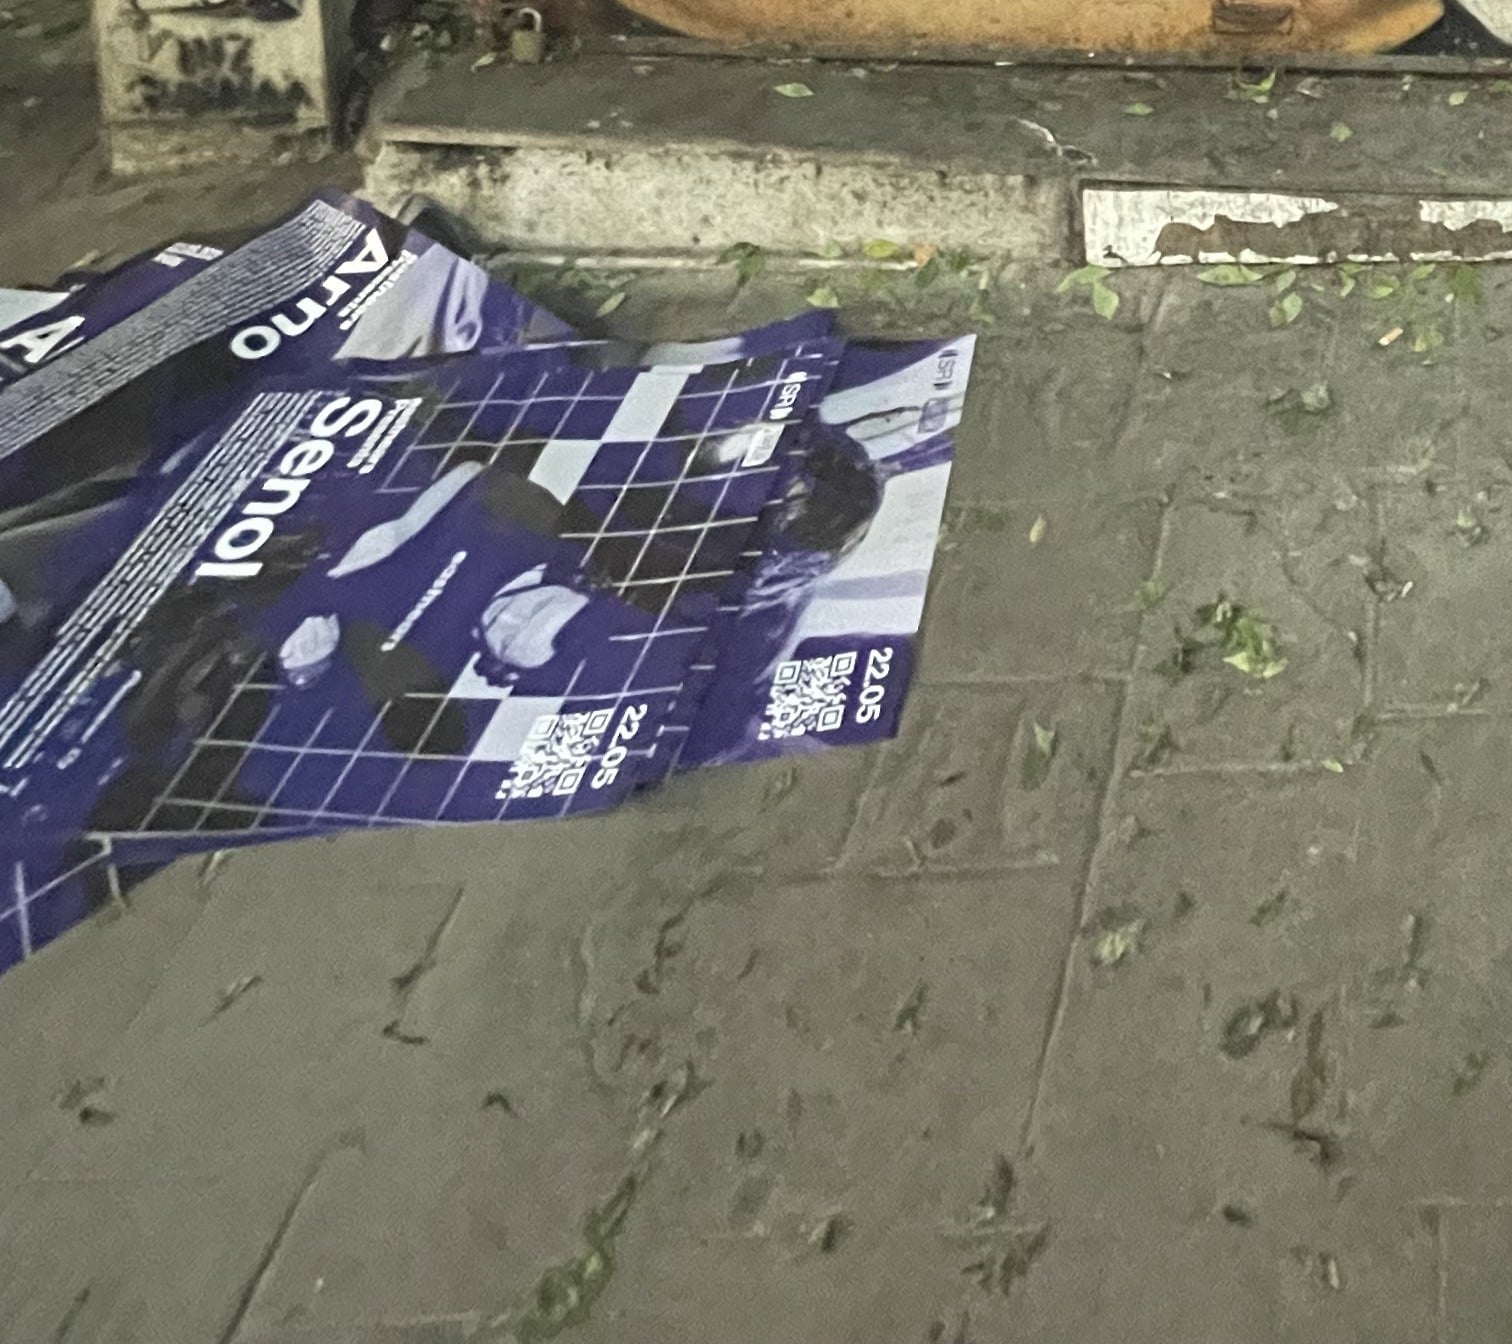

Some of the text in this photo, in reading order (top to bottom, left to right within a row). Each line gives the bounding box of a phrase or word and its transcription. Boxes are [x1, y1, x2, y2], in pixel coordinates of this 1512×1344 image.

[230, 228, 389, 359] Arno
[195, 397, 383, 576] Senol
[856, 647, 893, 724] 22.05
[590, 704, 648, 789] 22.05
